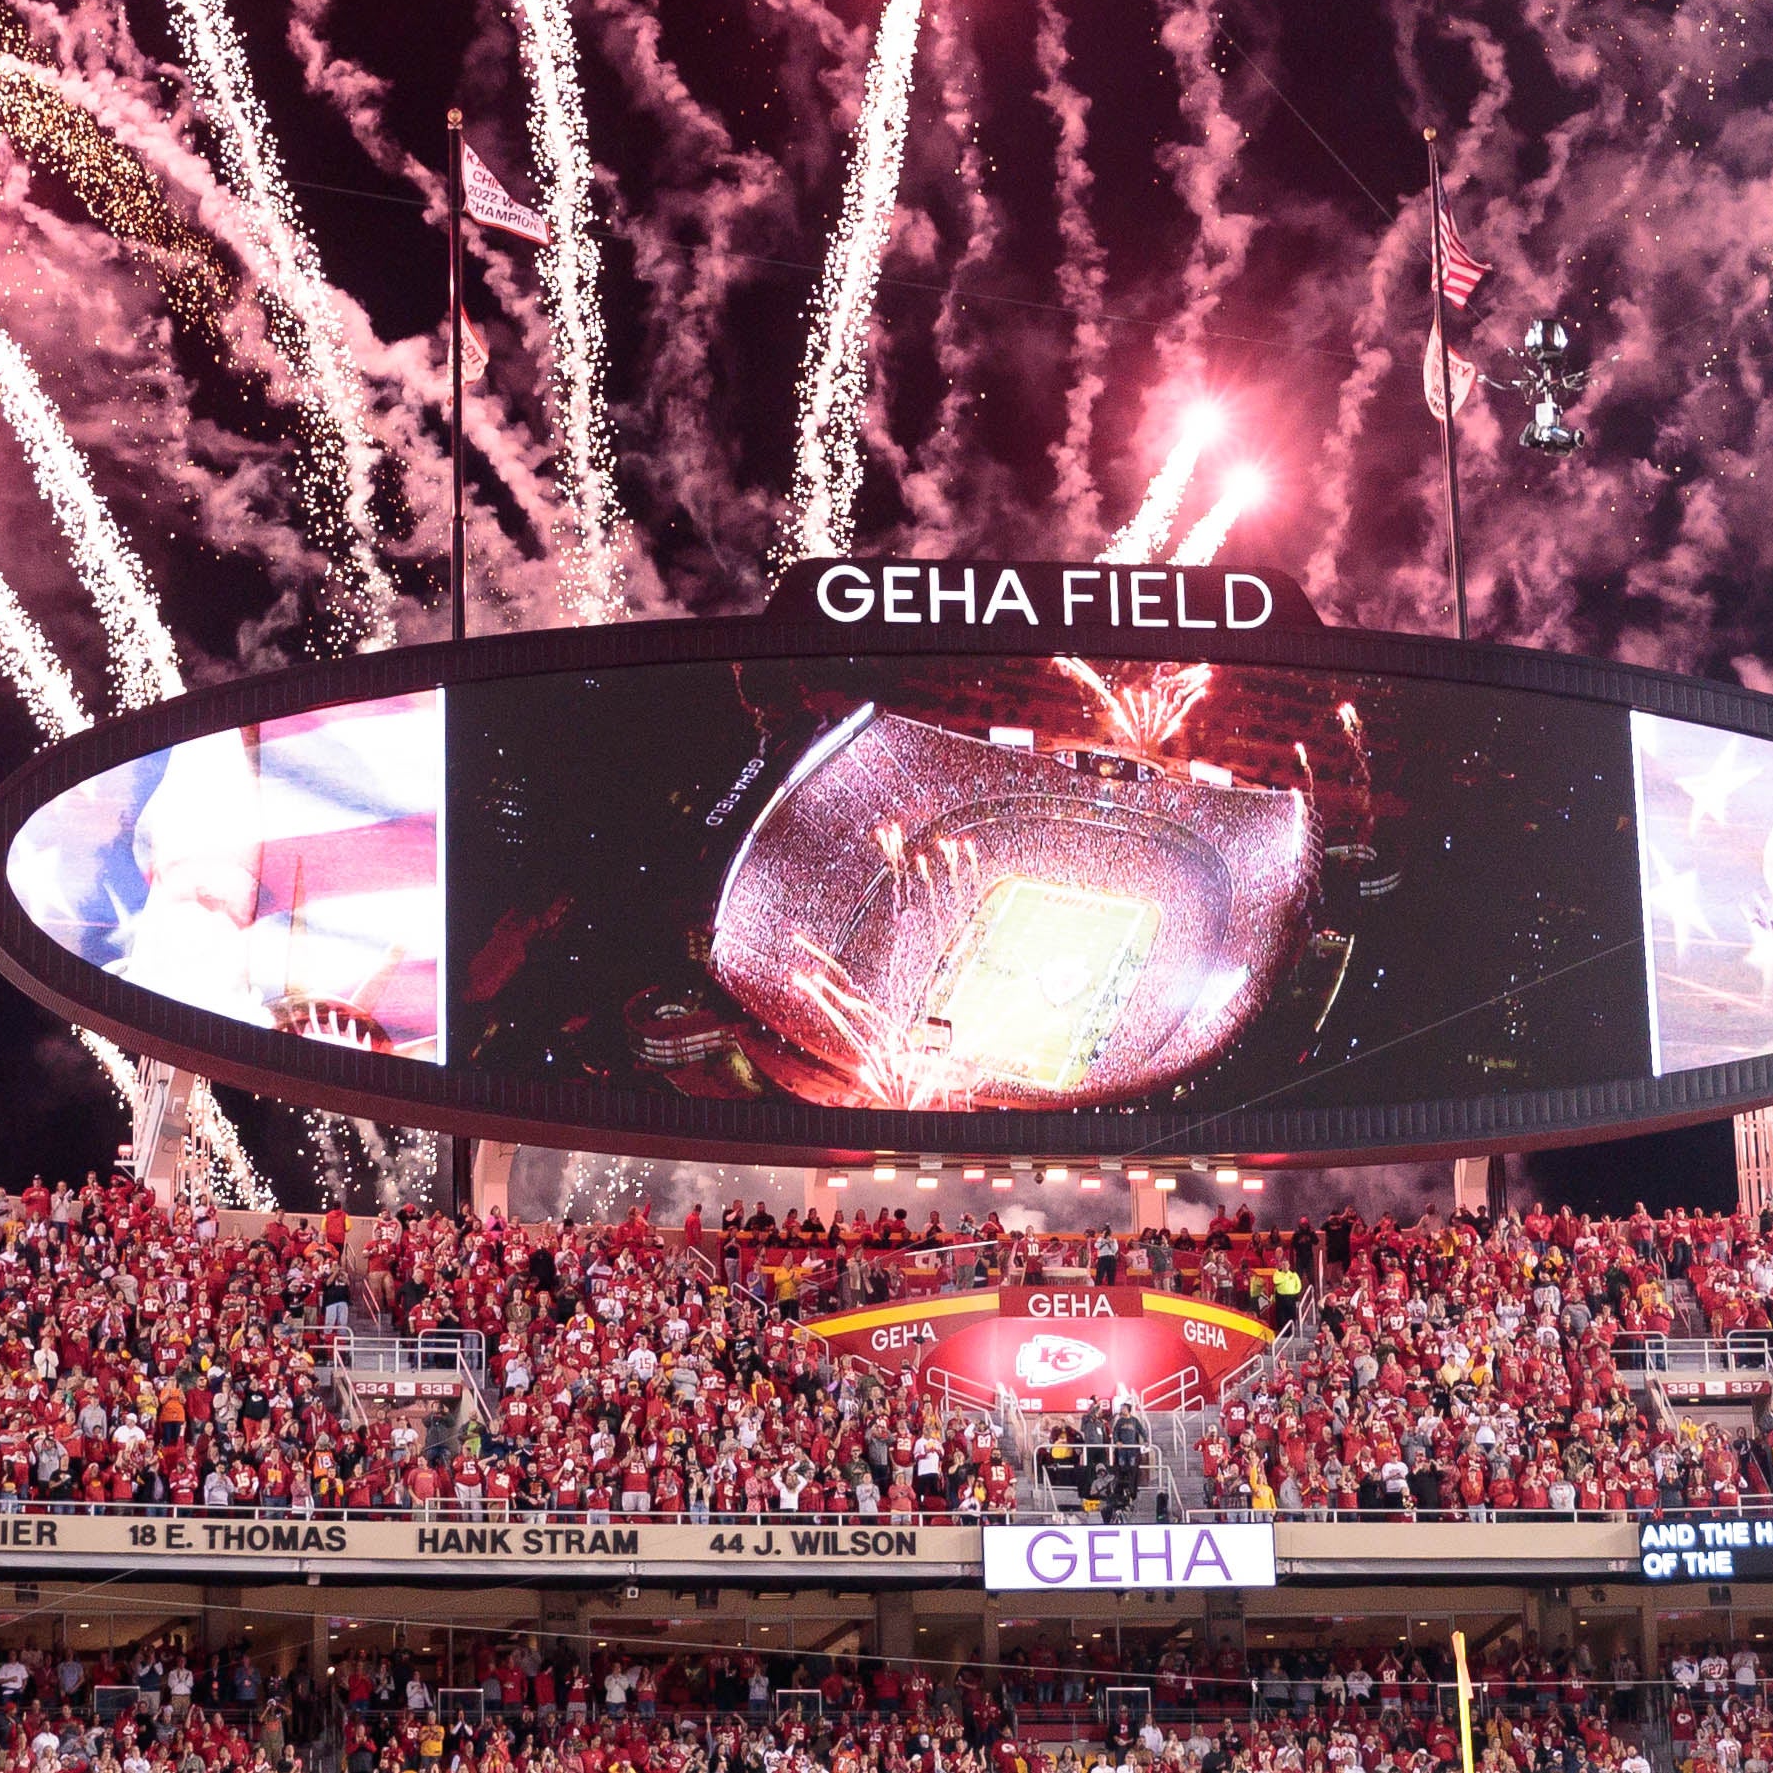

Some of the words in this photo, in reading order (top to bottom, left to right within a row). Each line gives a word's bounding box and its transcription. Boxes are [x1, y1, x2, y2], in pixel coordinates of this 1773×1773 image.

[817, 565, 1039, 625] GEHA
[1063, 569, 1273, 630] FIELD
[731, 759, 765, 790] GEHA
[706, 793, 740, 826] FIELD
[1027, 1293, 1116, 1318] GEHA
[871, 1321, 937, 1351] GEHA
[1183, 1320, 1229, 1350] GEHA
[355, 1383, 390, 1396] 334
[420, 1383, 454, 1396] 335
[1666, 1382, 1699, 1394] 336
[1730, 1380, 1764, 1393] 337
[129, 1525, 156, 1546] 18
[166, 1524, 192, 1549] E.
[203, 1524, 347, 1552] THOMAS
[419, 1529, 512, 1553] HANK
[523, 1529, 638, 1554] STRAM
[710, 1534, 745, 1553] 44
[754, 1531, 781, 1555] J.
[791, 1531, 916, 1556] WILSON
[1641, 1523, 1695, 1548] AND
[1700, 1522, 1751, 1546] THE
[1026, 1529, 1233, 1583] GEHA
[1643, 1553, 1677, 1576] OF
[1682, 1551, 1733, 1575] THE
